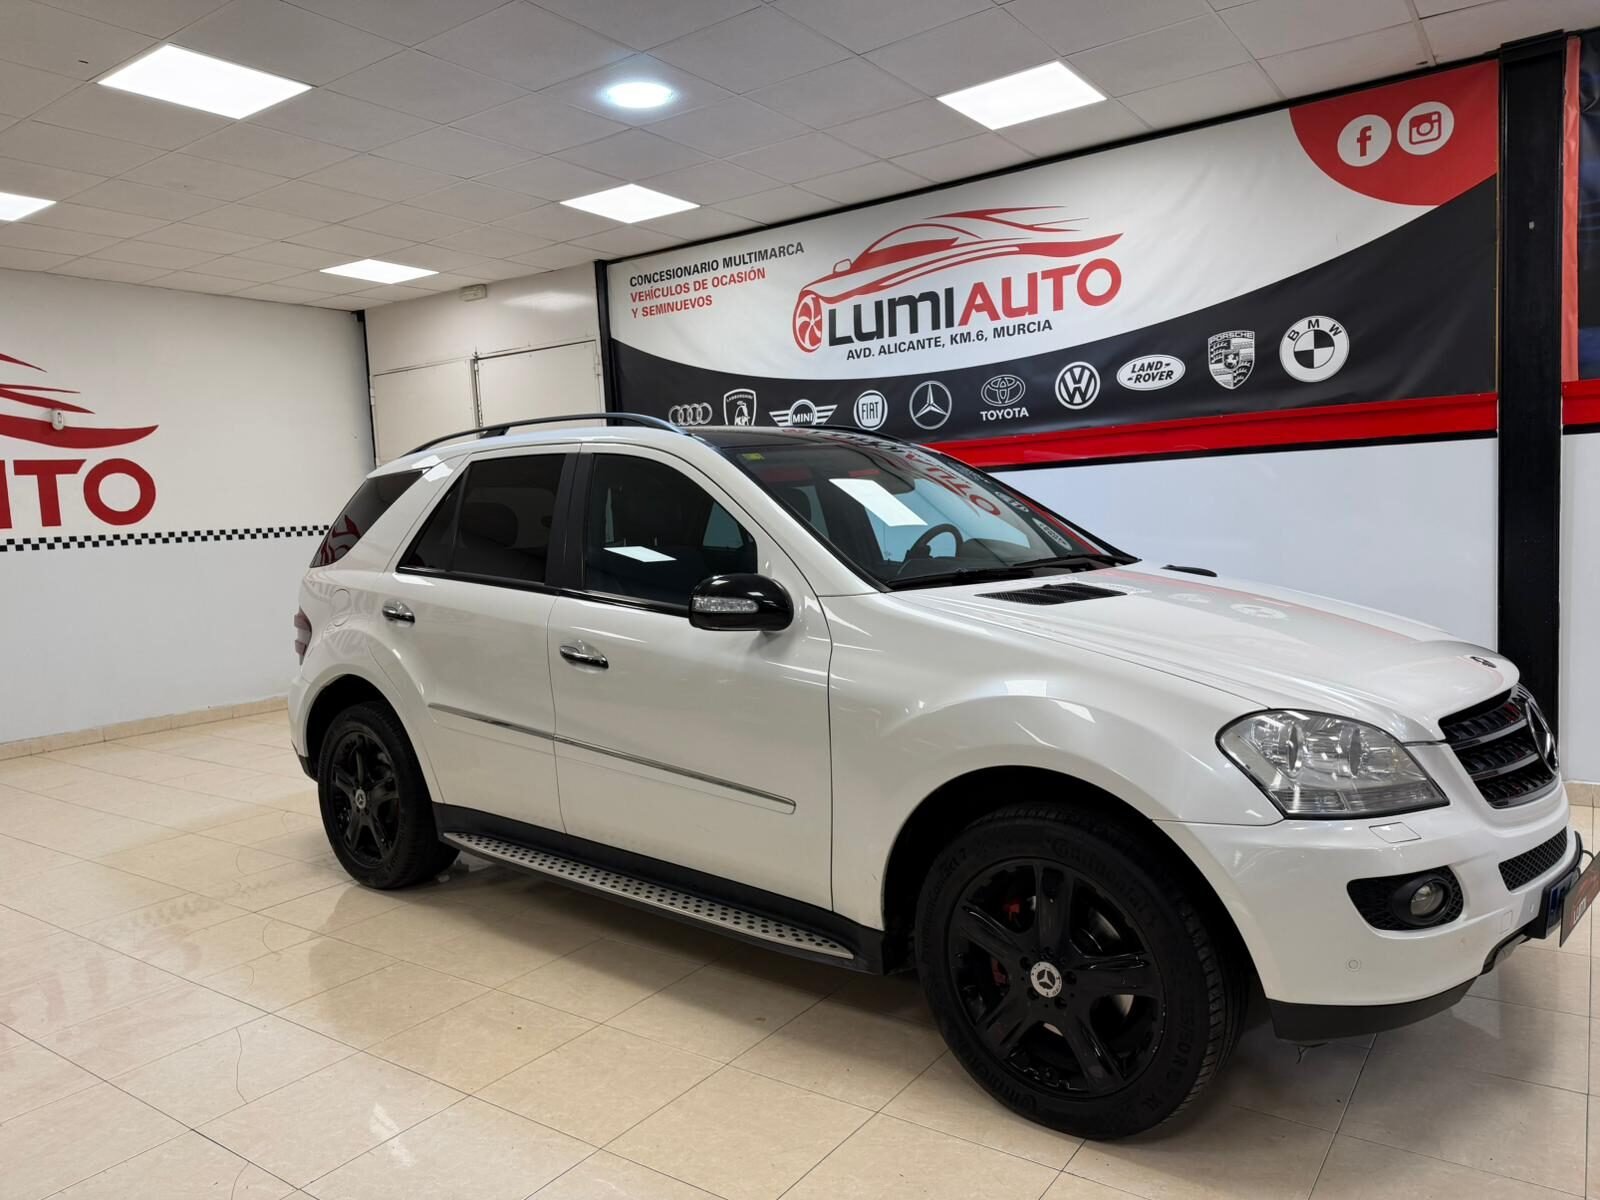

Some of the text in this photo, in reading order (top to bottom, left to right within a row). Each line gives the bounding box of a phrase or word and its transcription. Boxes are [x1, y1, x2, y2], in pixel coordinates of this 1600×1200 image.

[629, 241, 805, 287] CONCESIONARIO MULTIMARCA
[630, 266, 766, 303] VEHÍCULOS DE OCASIÓN
[631, 294, 713, 319] Y SEMINUEVOS
[846, 319, 1053, 361] AVD. ALICANTE, KM.6, MURCIA
[1286, 318, 1343, 342] BMW
[792, 412, 813, 424] MINI
[861, 400, 879, 421] FIAT
[980, 407, 1029, 422] TOYOTA
[0, 458, 157, 530] TO
